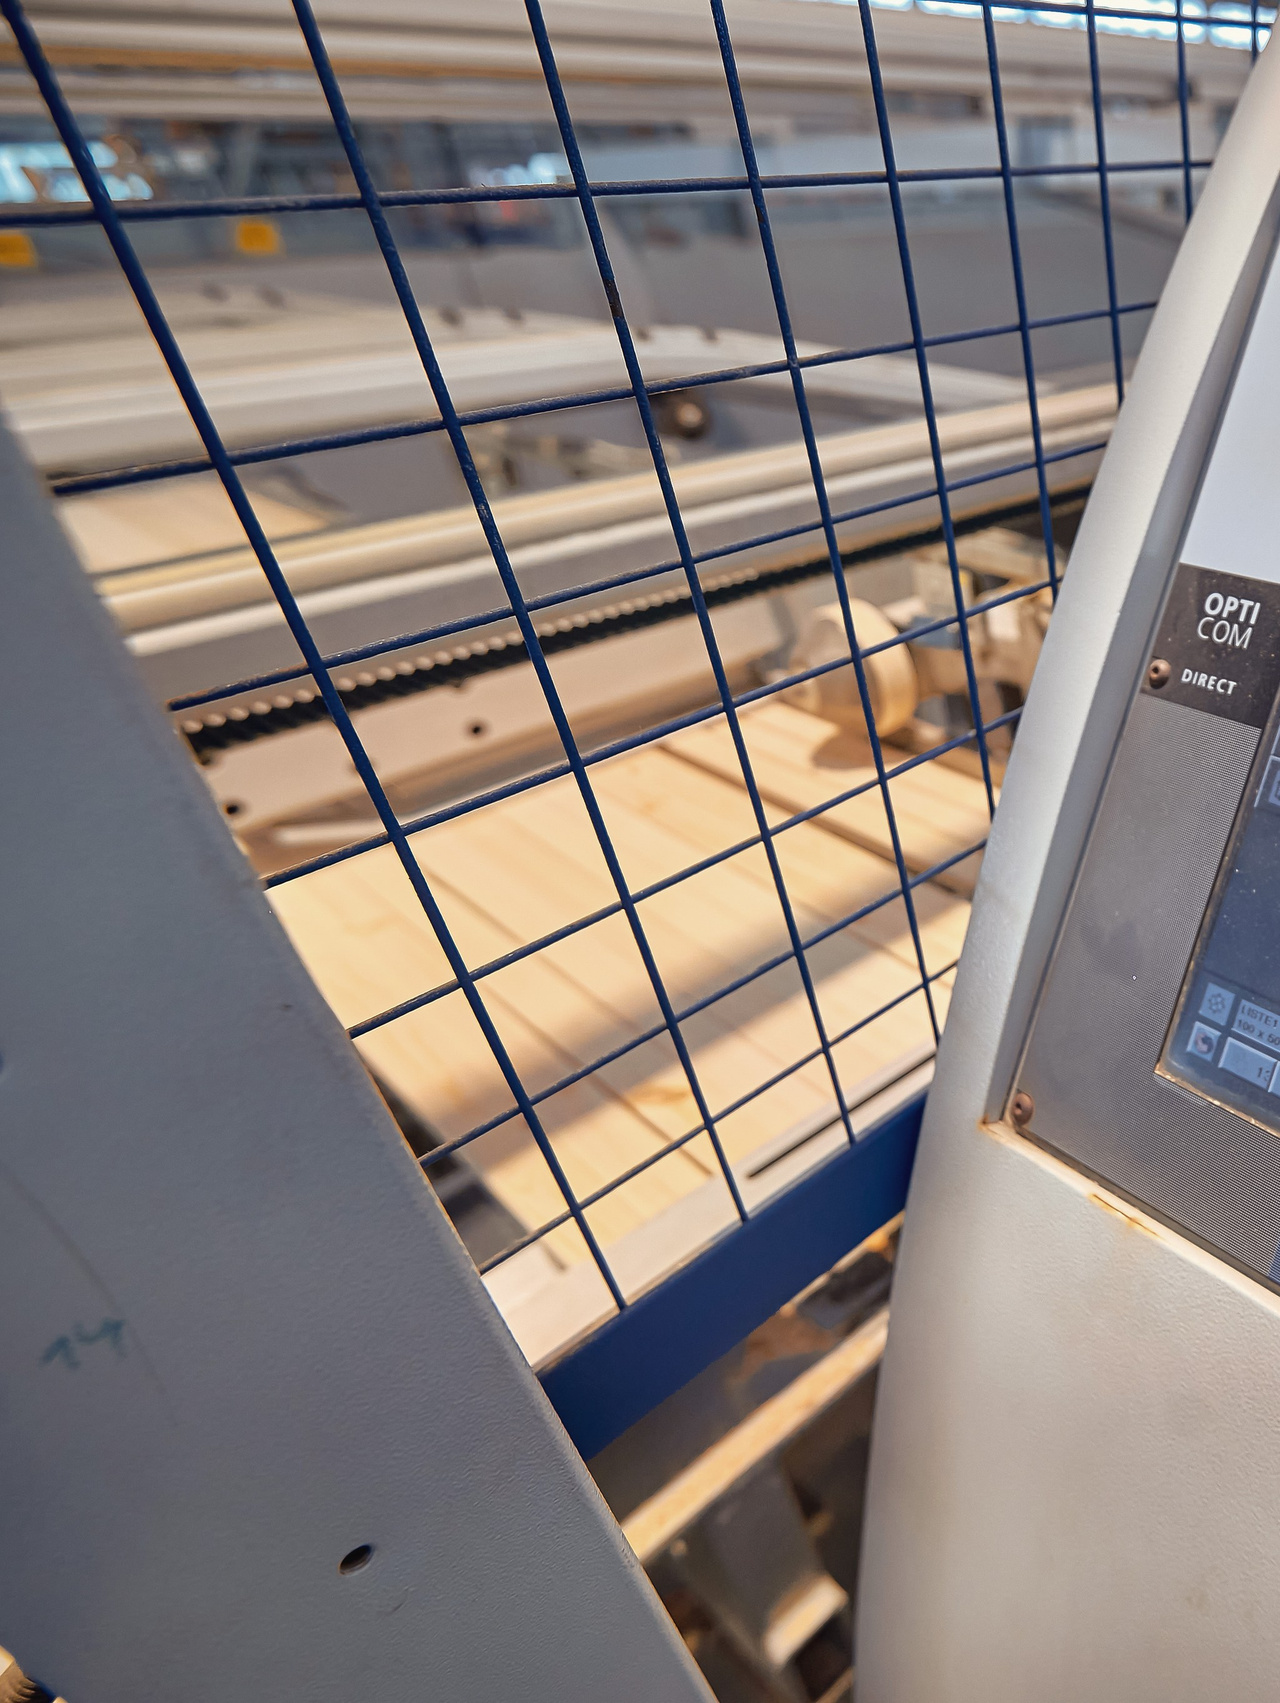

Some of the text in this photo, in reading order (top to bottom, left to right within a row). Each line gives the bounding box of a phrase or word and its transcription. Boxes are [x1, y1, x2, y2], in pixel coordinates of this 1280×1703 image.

[1204, 592, 1261, 624] OPTI
[1197, 616, 1254, 650] COM
[1181, 668, 1237, 695] DIRECT
[1241, 1004, 1278, 1028] LISTE1
[1238, 1020, 1256, 1032] 100
[1267, 1034, 1280, 1046] 50
